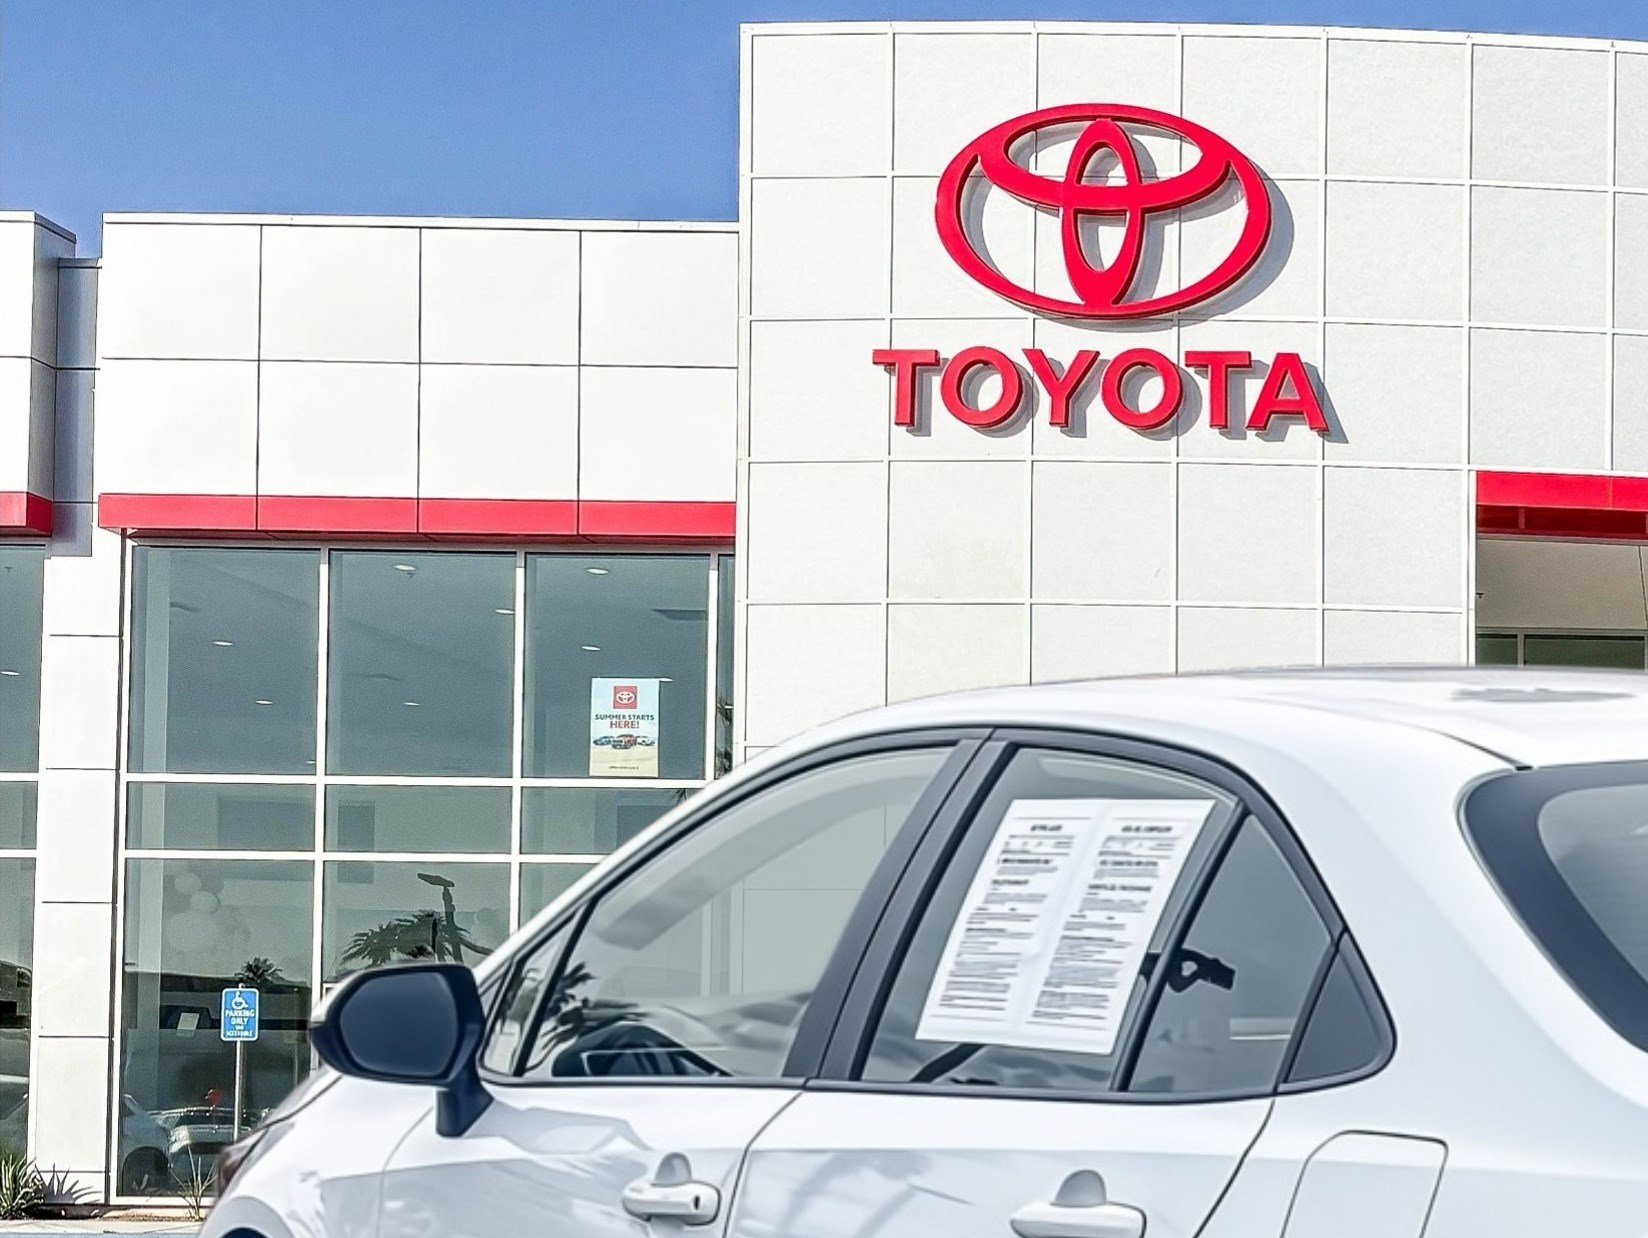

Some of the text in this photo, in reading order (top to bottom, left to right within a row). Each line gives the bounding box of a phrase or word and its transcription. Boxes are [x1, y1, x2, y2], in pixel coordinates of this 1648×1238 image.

[873, 345, 1330, 433] TOYOTA
[609, 721, 640, 729] HERE!
[225, 1009, 255, 1017] PARKING
[230, 1017, 249, 1025] ONLY
